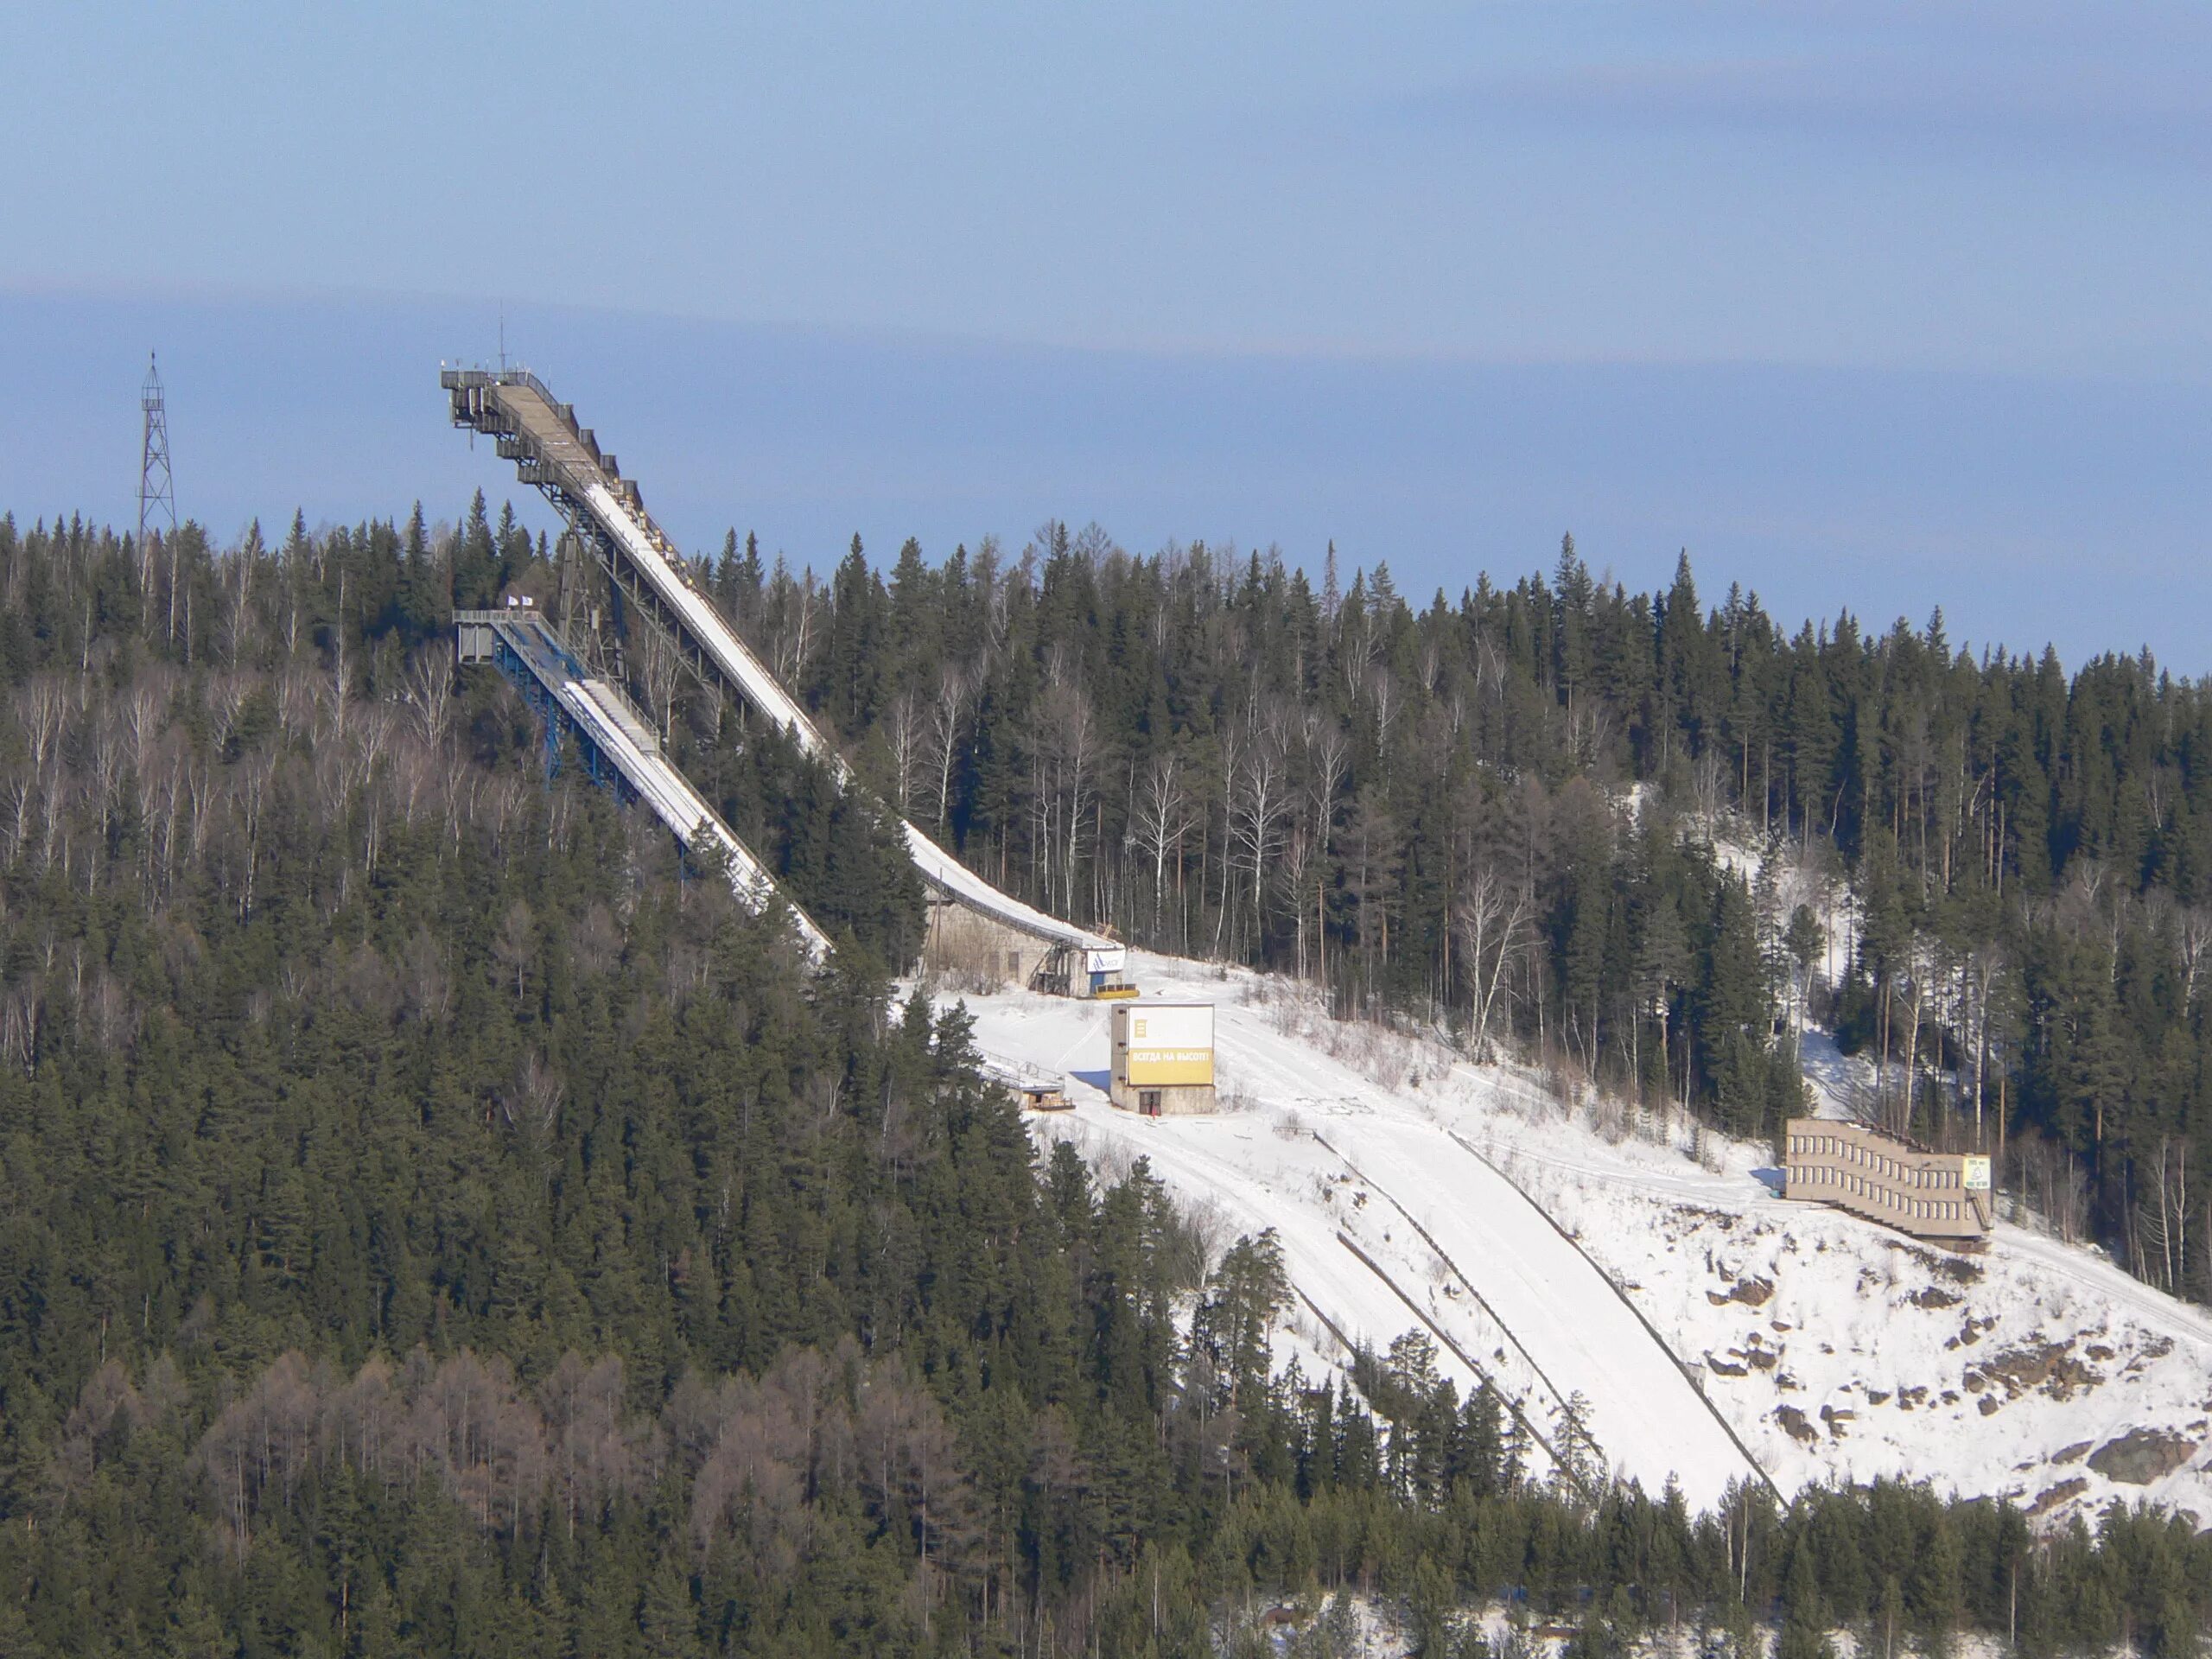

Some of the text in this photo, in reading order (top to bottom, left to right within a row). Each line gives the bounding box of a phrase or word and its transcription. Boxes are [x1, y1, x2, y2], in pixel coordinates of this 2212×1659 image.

[1133, 1052, 1209, 1063] ВСЕГДА НА ВЫСОТЕ!
